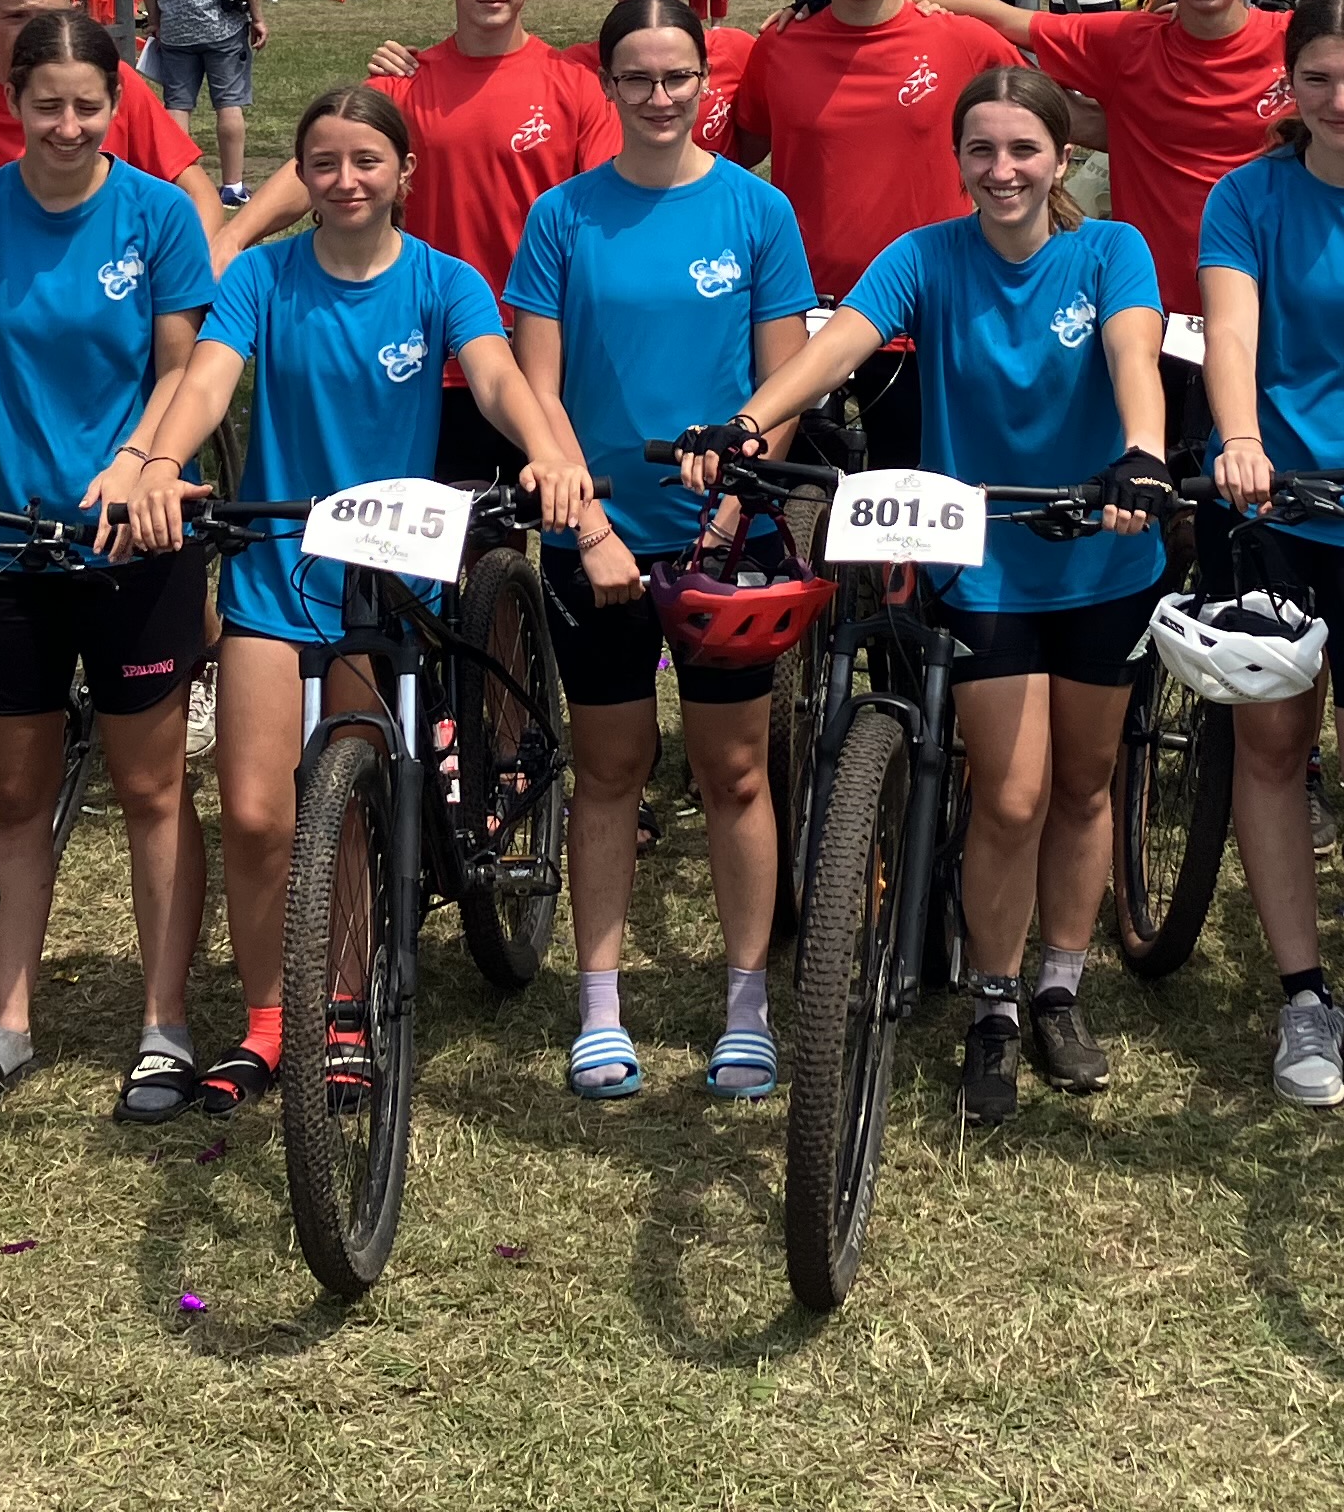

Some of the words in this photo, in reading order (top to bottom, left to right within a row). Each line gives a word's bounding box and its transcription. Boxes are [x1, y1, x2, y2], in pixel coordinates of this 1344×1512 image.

[331, 498, 446, 539] 801.5
[850, 497, 965, 530] 801.6
[122, 658, 174, 678] SPALDING
[140, 1055, 177, 1071] NIKE
